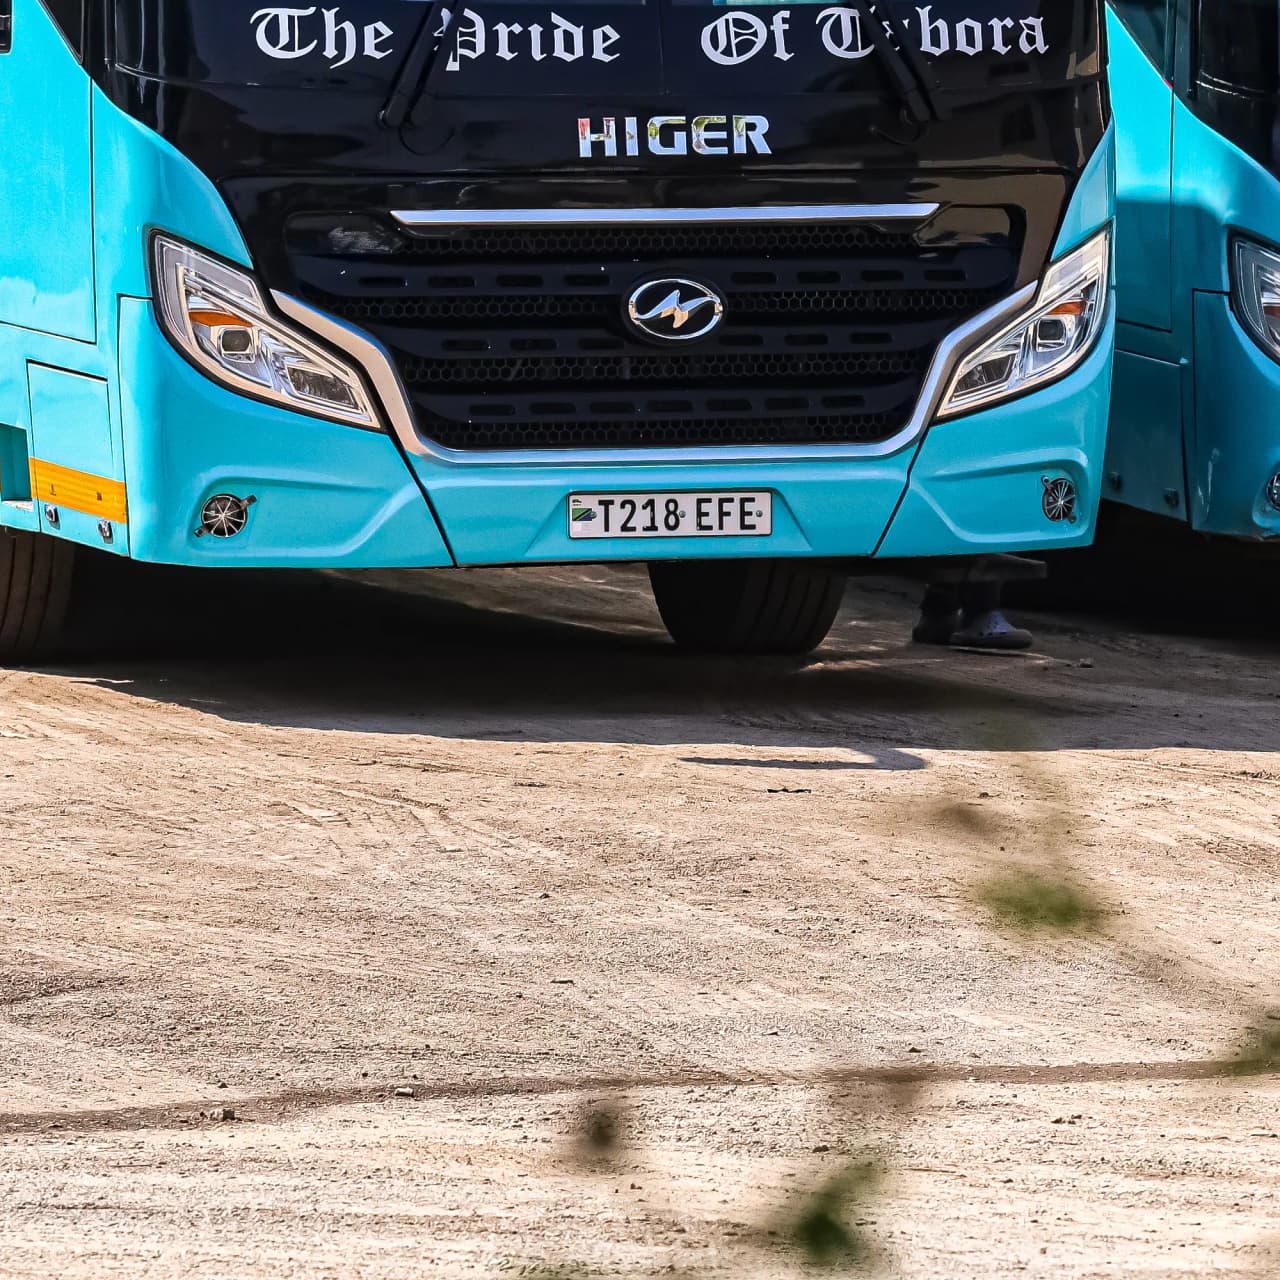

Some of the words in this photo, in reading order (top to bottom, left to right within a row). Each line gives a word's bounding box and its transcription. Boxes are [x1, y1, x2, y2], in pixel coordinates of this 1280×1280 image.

[250, 6, 394, 70] The
[700, 10, 795, 66] Of
[815, 5, 1050, 60] Tbora
[577, 115, 773, 158] HIGER
[597, 497, 681, 533] T218
[695, 496, 757, 531] EFE
